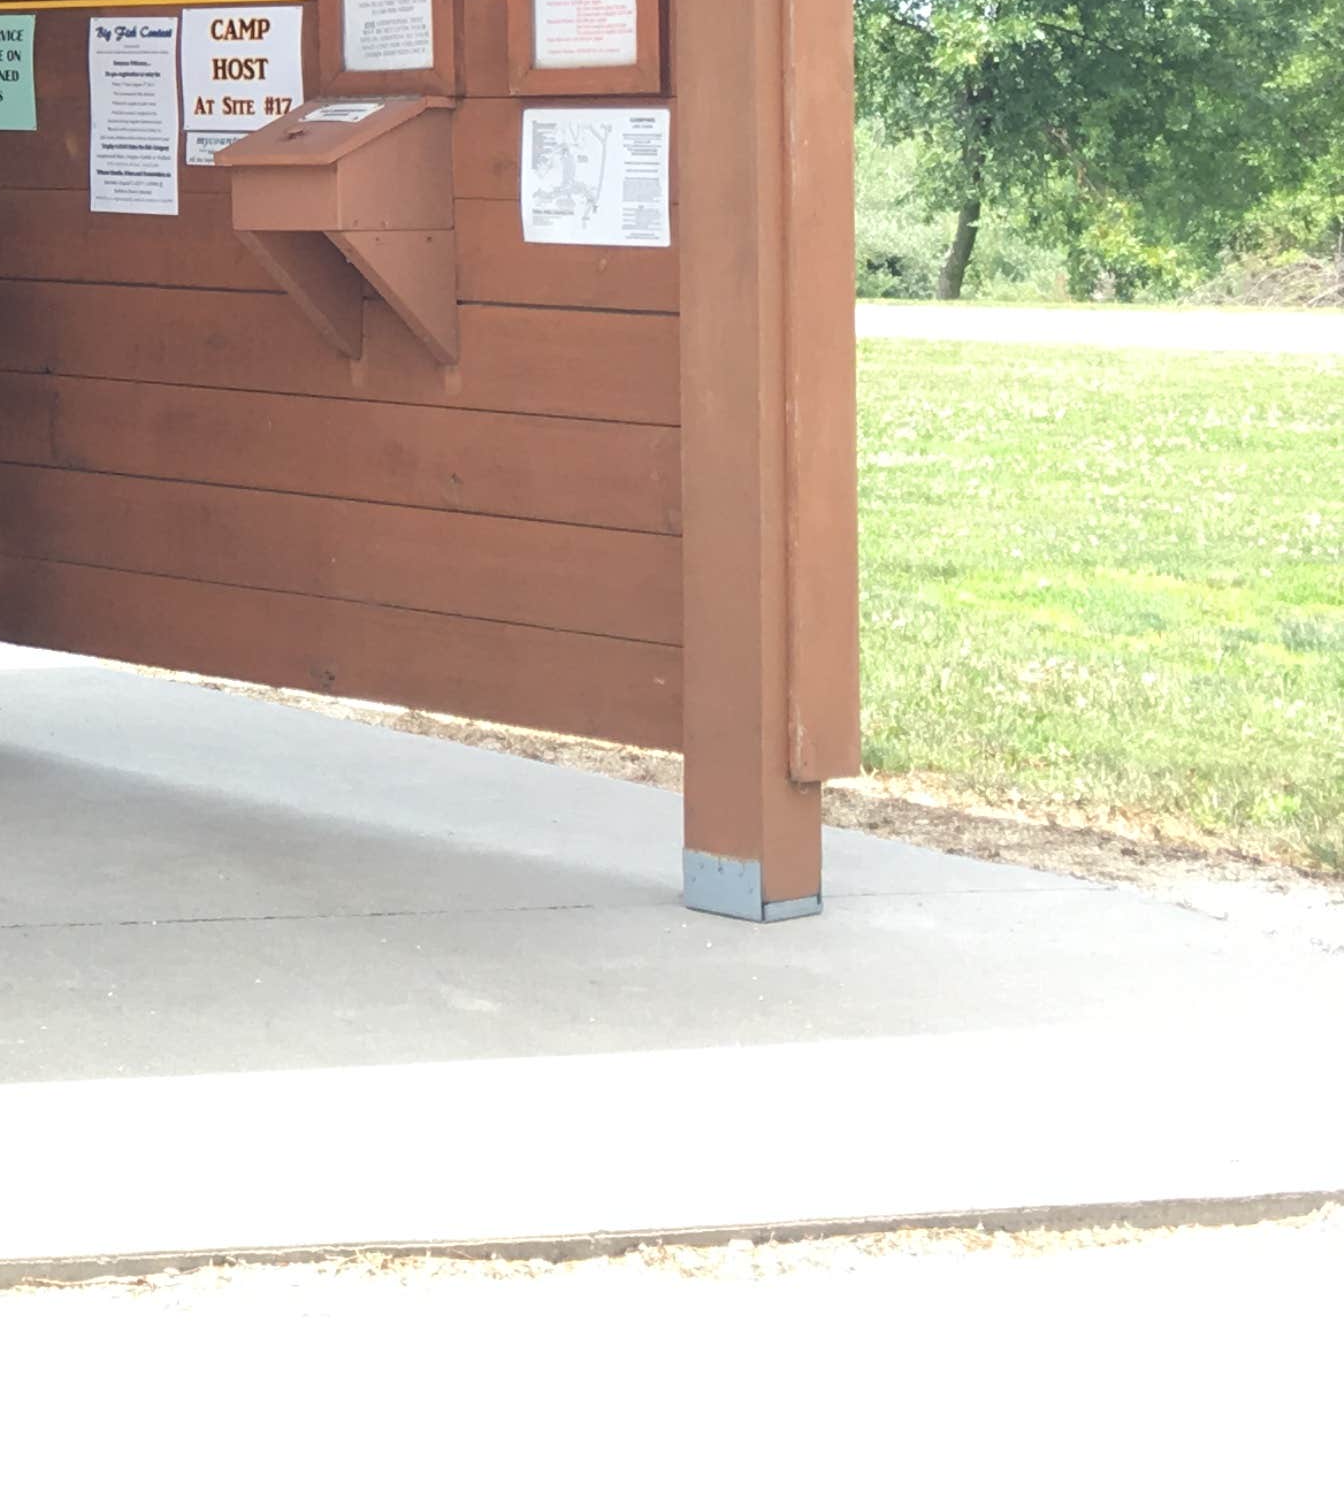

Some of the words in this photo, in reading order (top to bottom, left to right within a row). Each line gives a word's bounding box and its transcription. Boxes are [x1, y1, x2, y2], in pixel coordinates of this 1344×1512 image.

[95, 26, 111, 42] Big
[114, 26, 137, 42] Fish
[140, 26, 172, 38] Contest
[211, 18, 270, 40] CAMP
[7, 50, 21, 62] ON
[212, 58, 268, 80] HOST
[265, 98, 292, 115] #17
